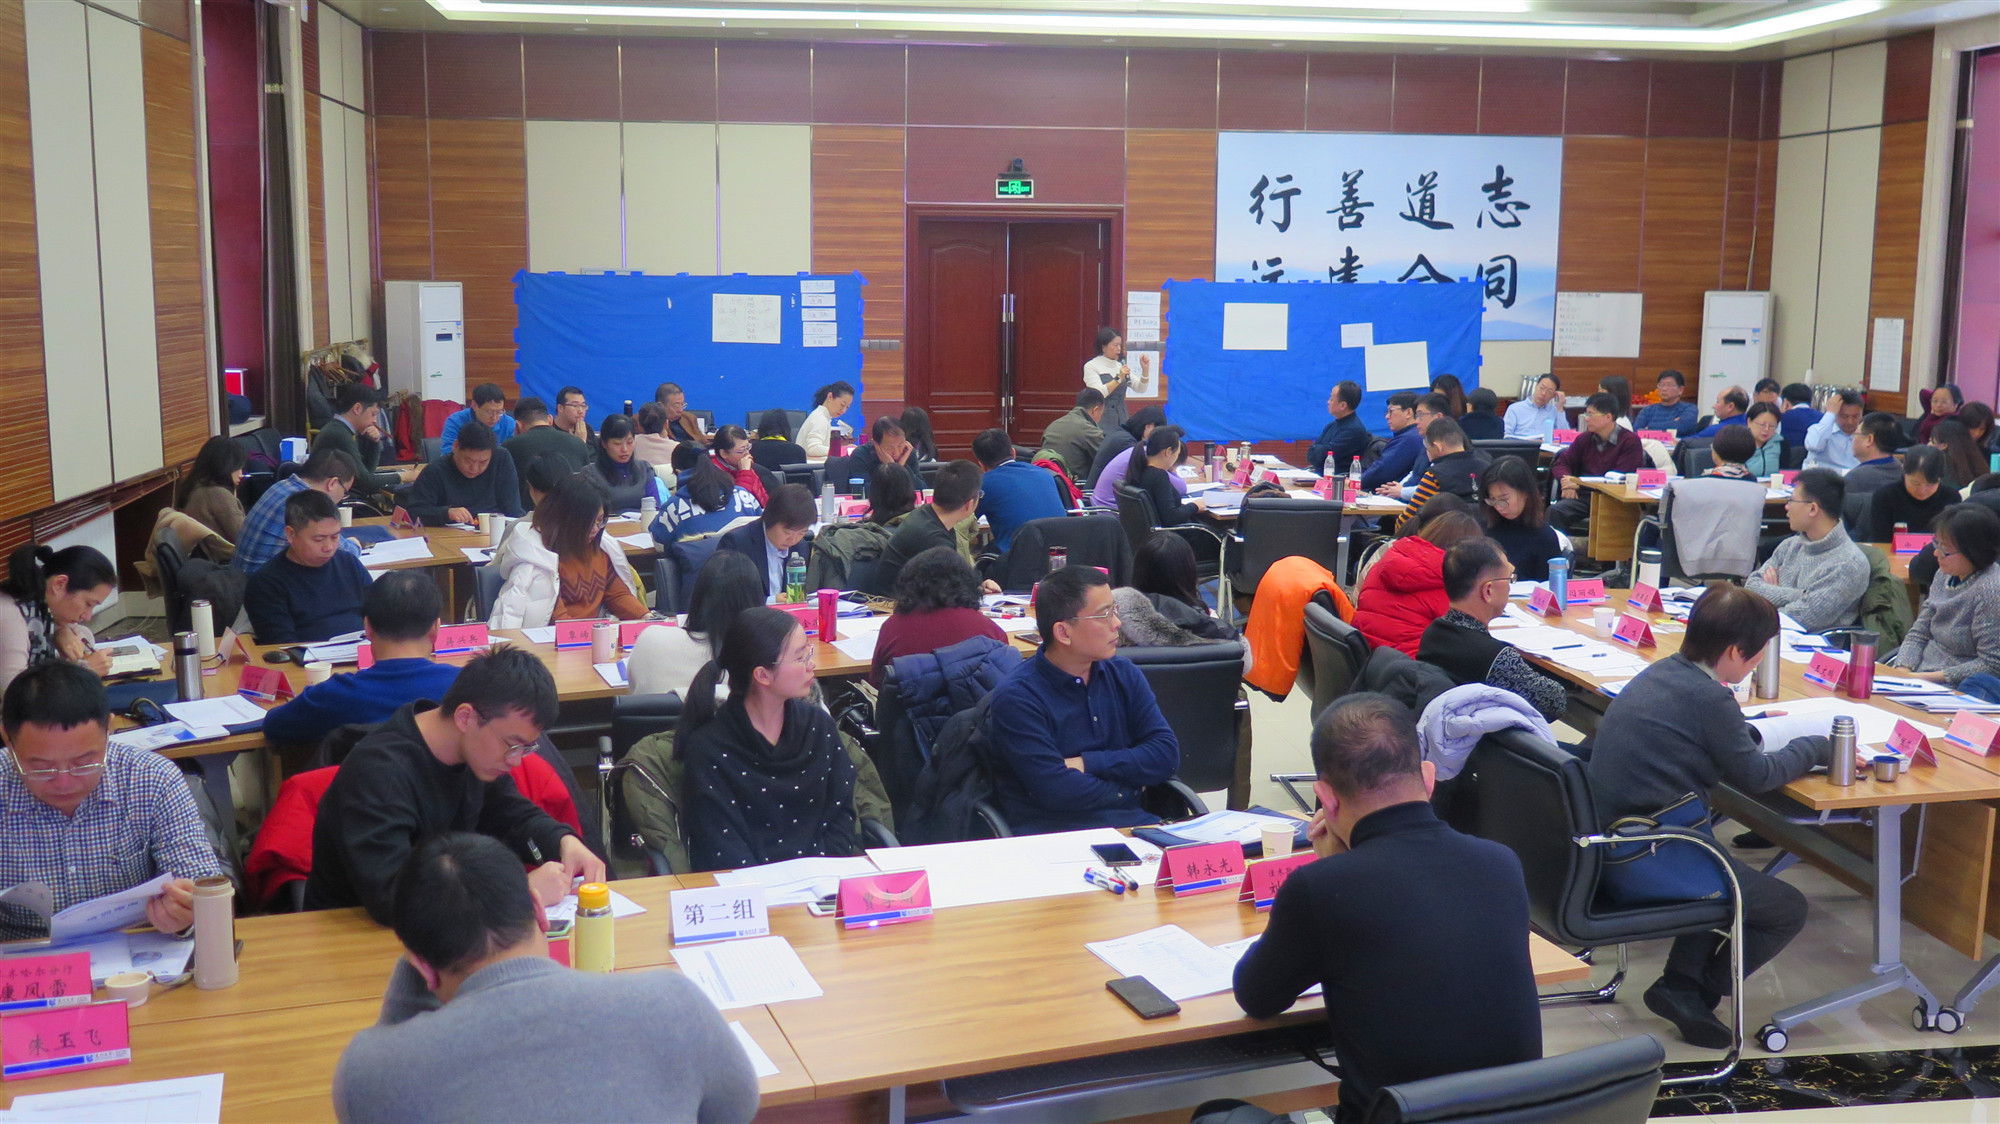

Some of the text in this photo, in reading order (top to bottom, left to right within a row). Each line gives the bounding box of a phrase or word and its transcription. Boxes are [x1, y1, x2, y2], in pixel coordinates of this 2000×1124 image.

[1186, 858, 1233, 879] 韩永光
[683, 898, 755, 927] 第二组
[0, 964, 73, 978] 齐哈尔分行
[1, 979, 68, 1002] 康凤雷
[27, 1028, 103, 1056] 朱玉飞
